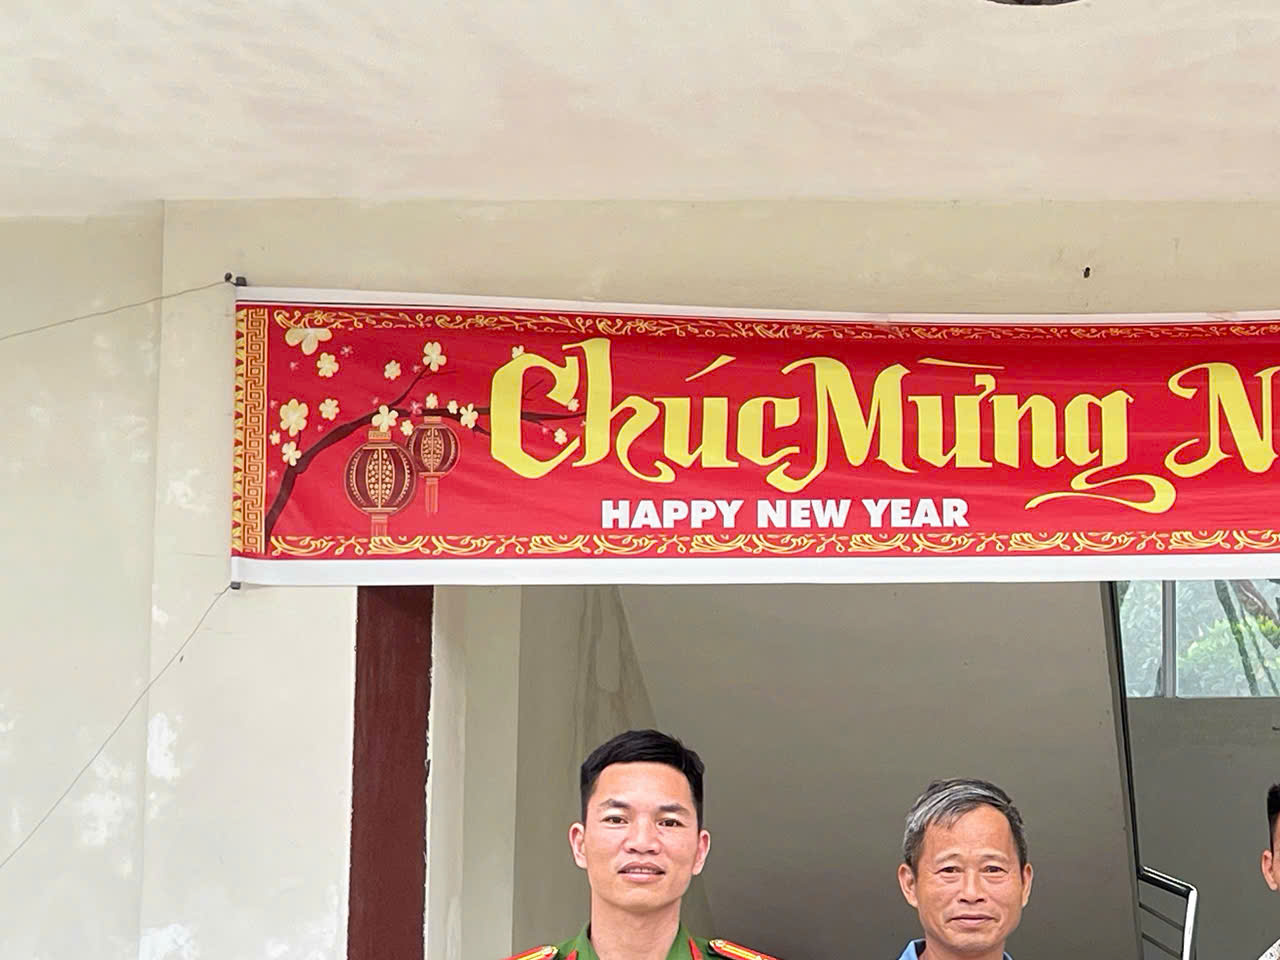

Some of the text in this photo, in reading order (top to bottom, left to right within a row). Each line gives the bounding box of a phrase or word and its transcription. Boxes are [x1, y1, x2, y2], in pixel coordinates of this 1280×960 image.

[490, 338, 800, 483] Chúc
[766, 356, 1177, 513] Mừng
[601, 498, 969, 529] HAPPY NEW YEAR
